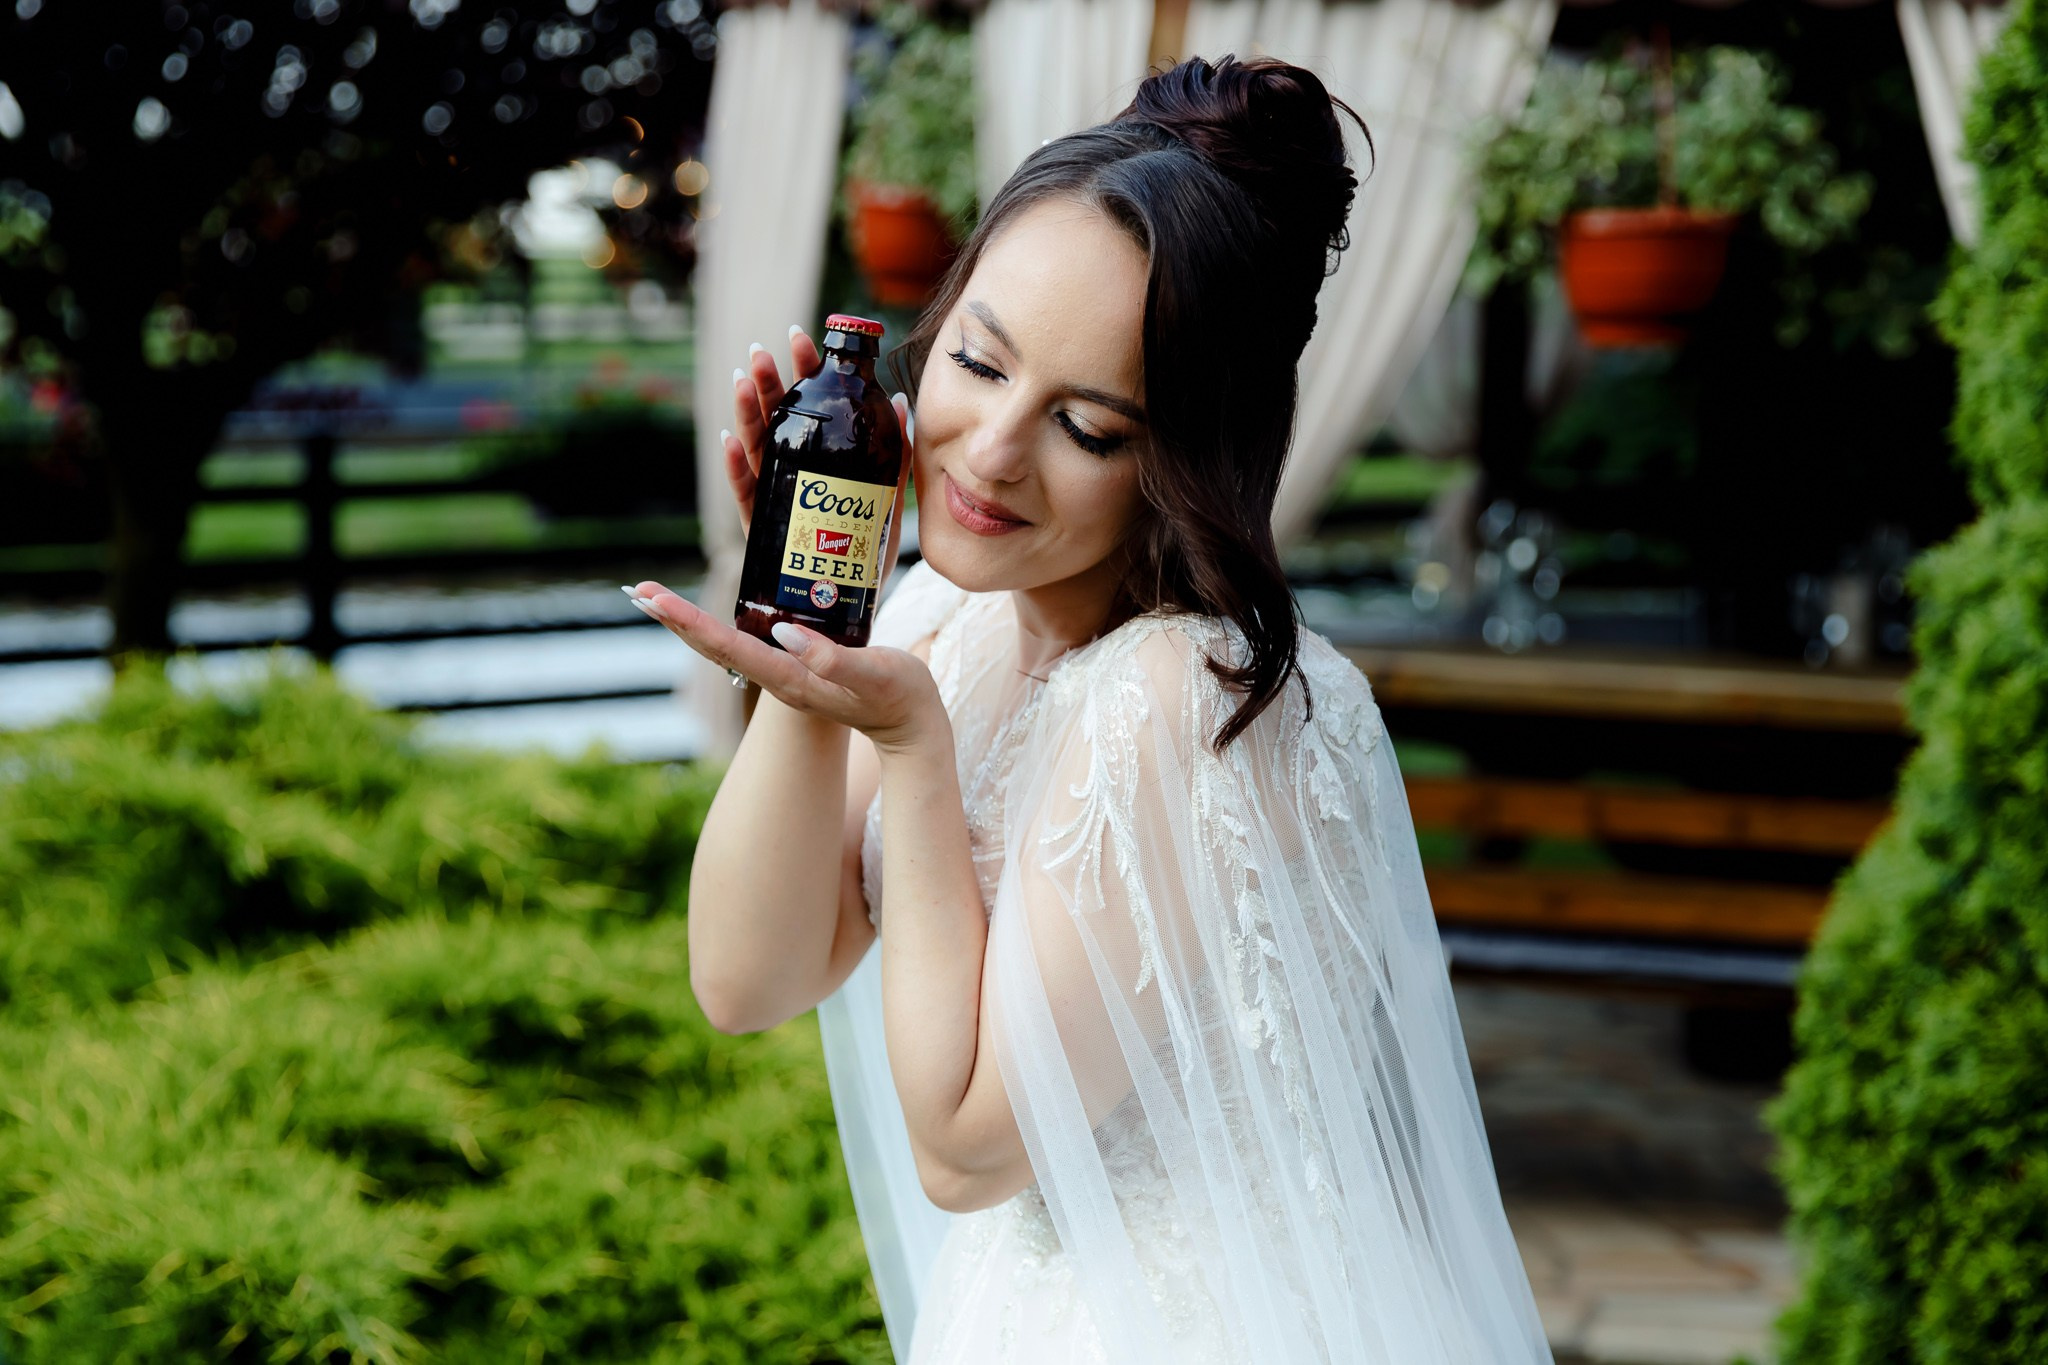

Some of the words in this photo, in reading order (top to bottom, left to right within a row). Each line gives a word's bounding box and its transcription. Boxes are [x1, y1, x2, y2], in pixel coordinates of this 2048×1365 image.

[799, 479, 875, 520] Coors
[796, 513, 873, 533] GOLDEN
[818, 532, 850, 552] Banquet
[788, 552, 864, 581] BEER
[791, 586, 808, 596] FLUID
